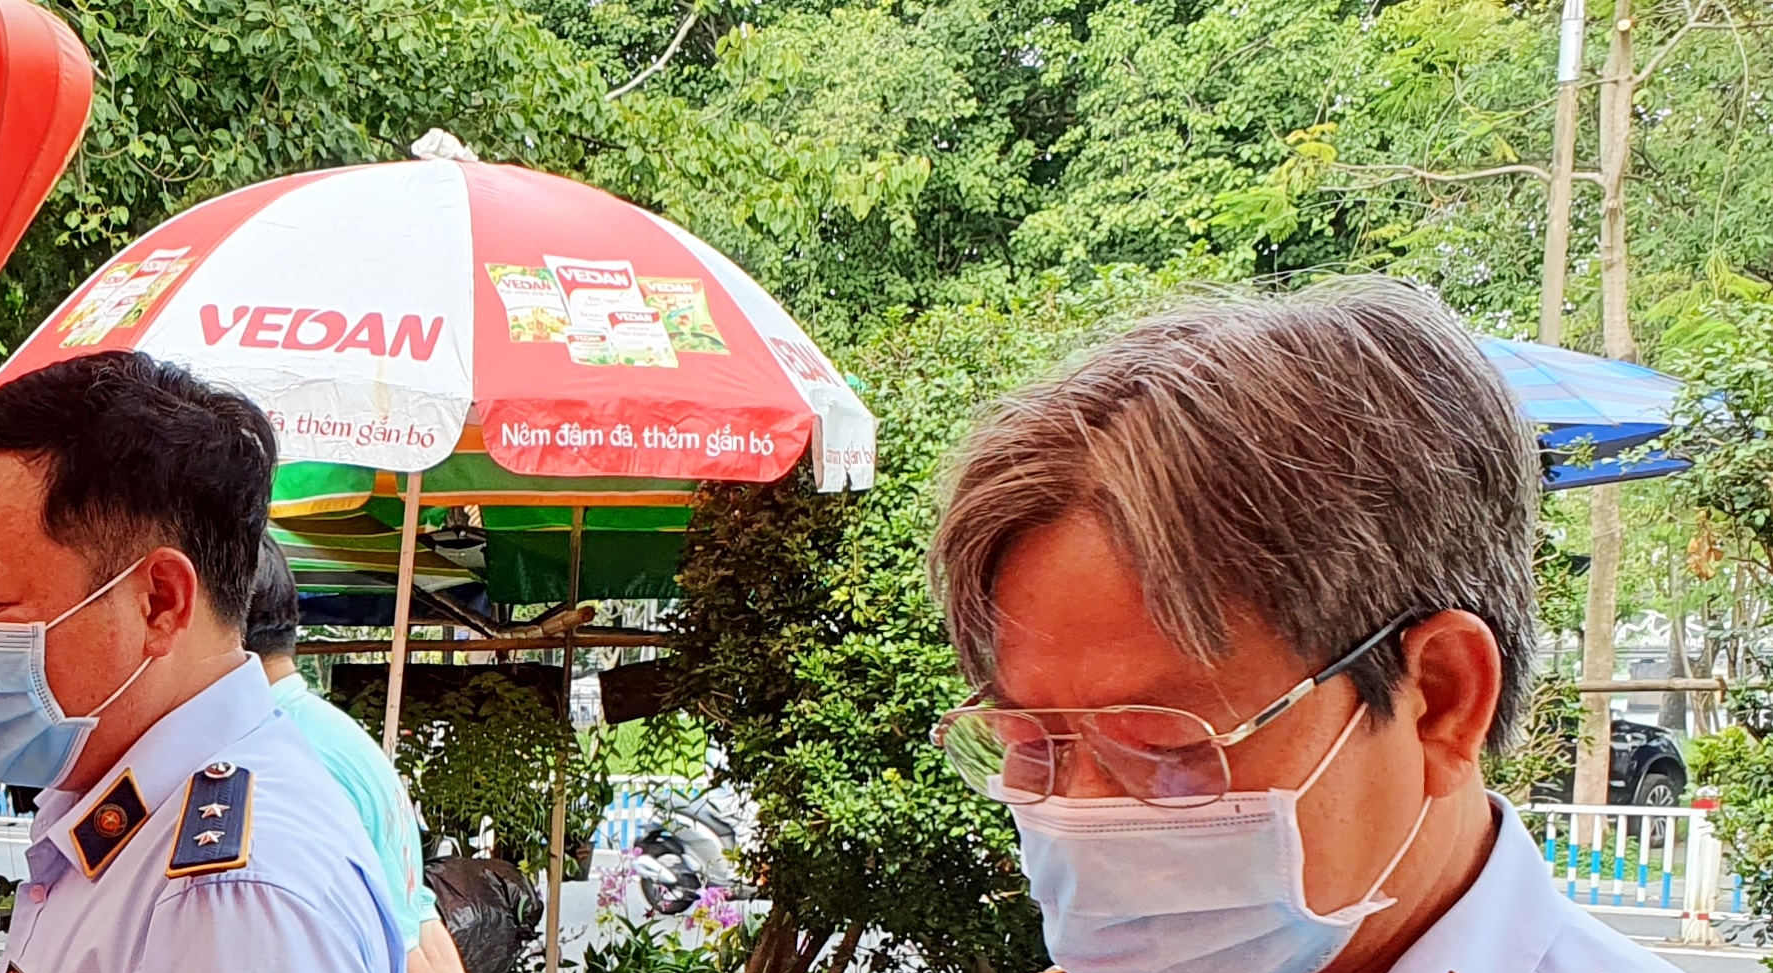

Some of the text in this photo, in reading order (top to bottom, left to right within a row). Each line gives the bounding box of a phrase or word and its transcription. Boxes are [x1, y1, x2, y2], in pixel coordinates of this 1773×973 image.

[502, 279, 552, 291] VEDAN
[558, 267, 629, 288] VEDAN
[199, 303, 444, 361] VEDAN
[296, 411, 352, 438] thêm
[356, 415, 401, 447] gắn
[406, 423, 435, 449] bó
[501, 421, 551, 447] Nêm
[555, 421, 603, 454] đậm
[642, 424, 700, 450] thêm
[705, 424, 746, 457] gắn
[749, 431, 775, 456] bó
